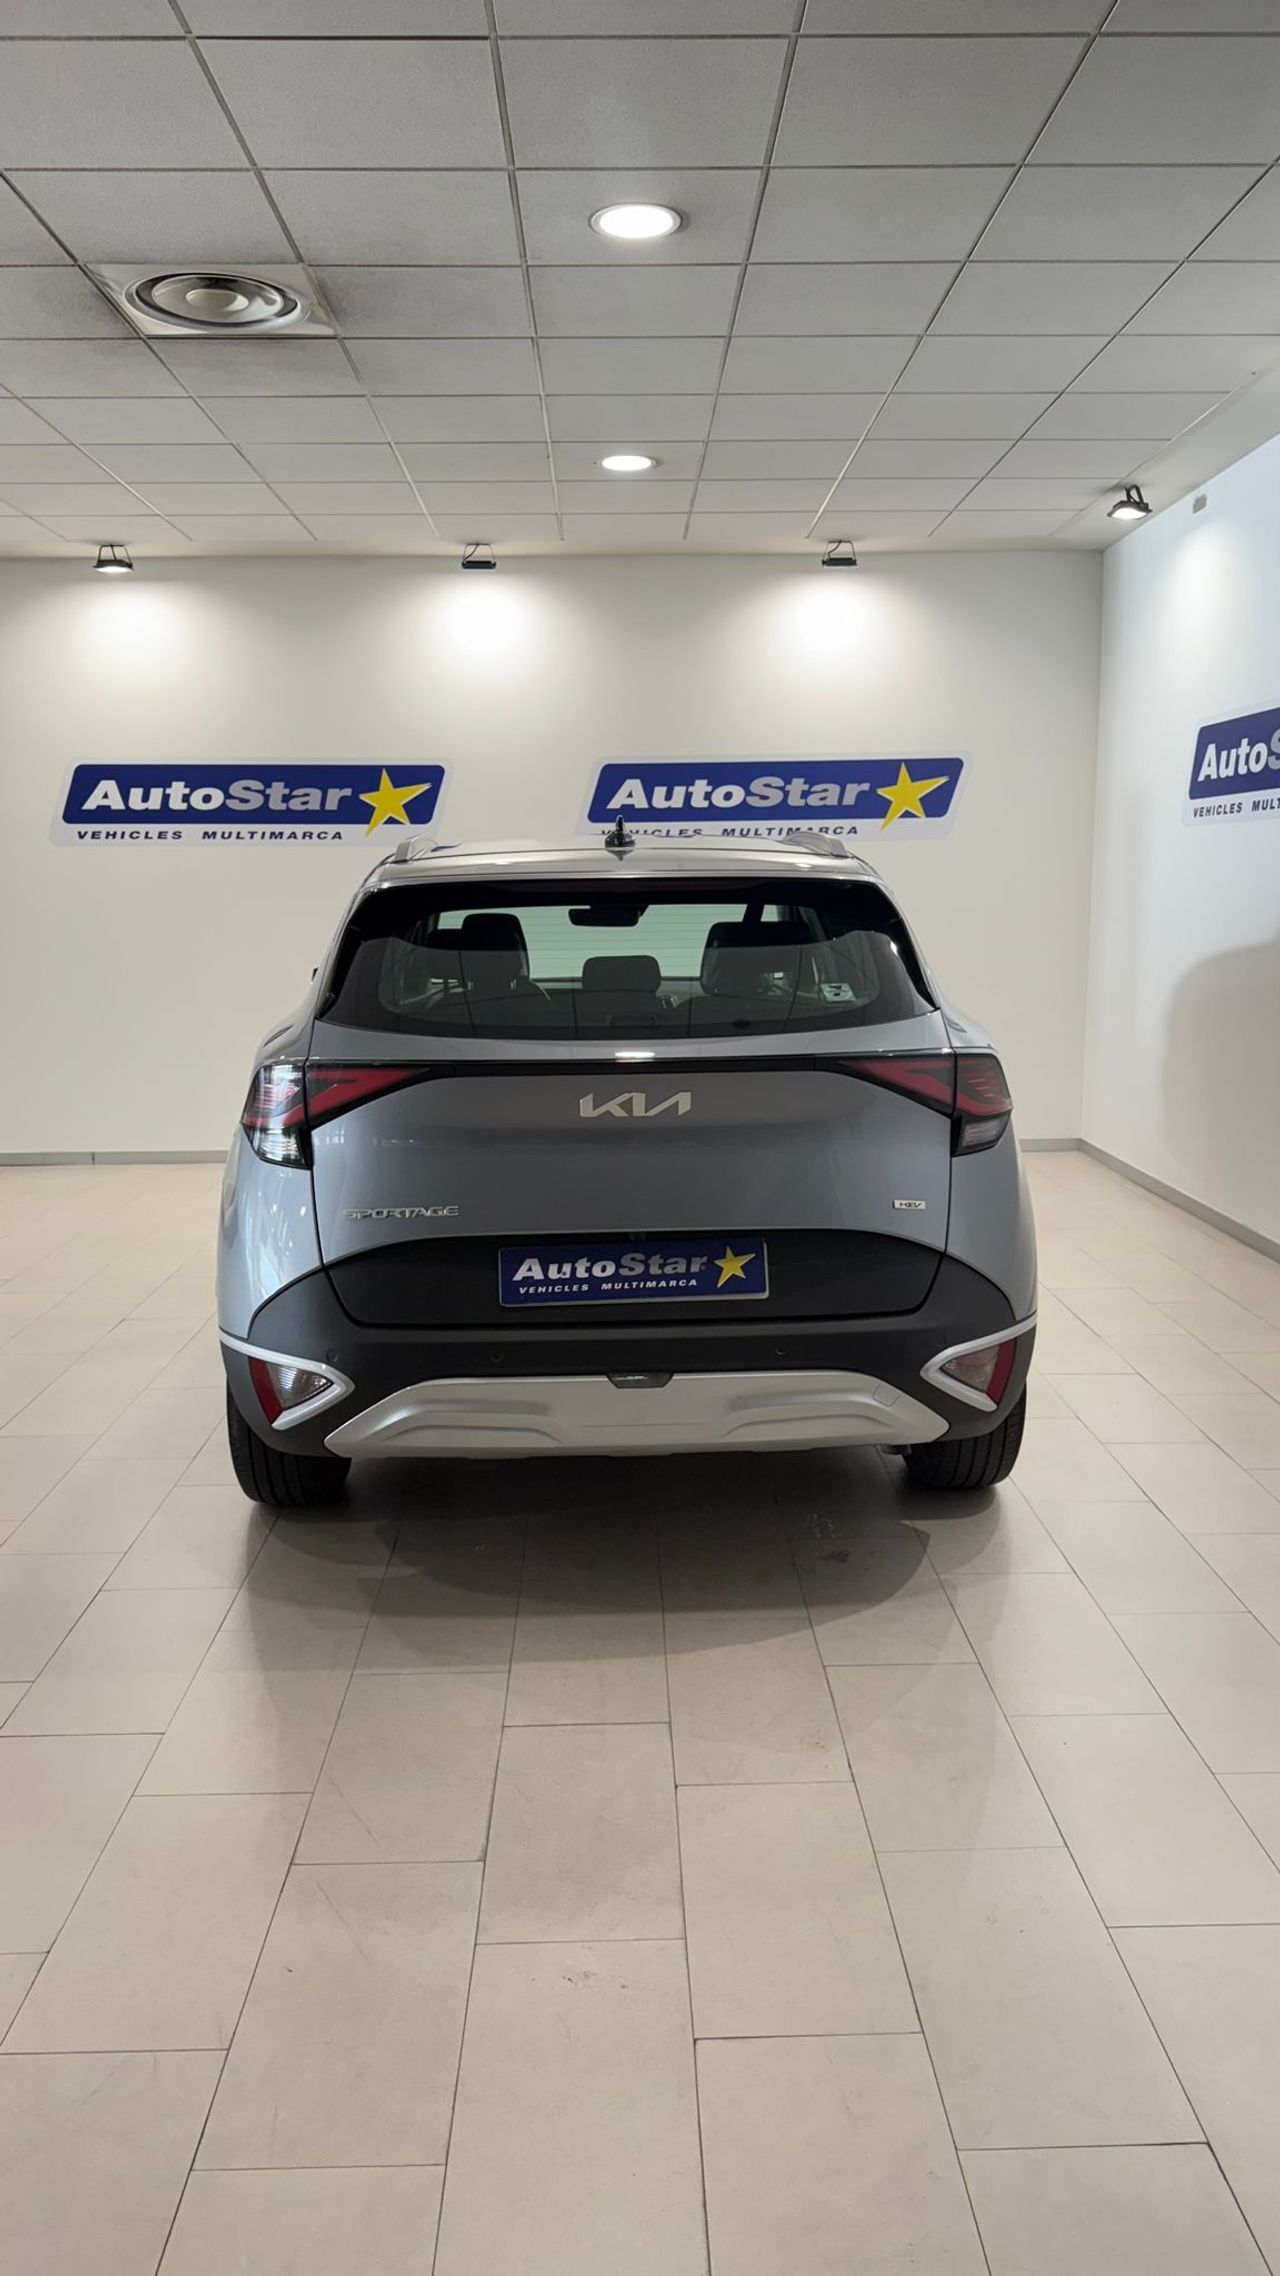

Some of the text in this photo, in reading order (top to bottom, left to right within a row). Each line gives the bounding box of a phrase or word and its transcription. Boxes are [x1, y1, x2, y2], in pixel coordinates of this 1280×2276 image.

[81, 779, 352, 811] AutoStar
[606, 776, 870, 809] AutoStar
[1193, 802, 1243, 818] VEHICLES
[77, 830, 343, 841] VEHICLES MULTIMARCA
[601, 828, 703, 836] VHICLES
[579, 1091, 692, 1118] KIA
[343, 1205, 460, 1219] SPORTAGE
[512, 1252, 708, 1281] AutoStar
[519, 1279, 697, 1294] VEHICLES MULTIMARCA
